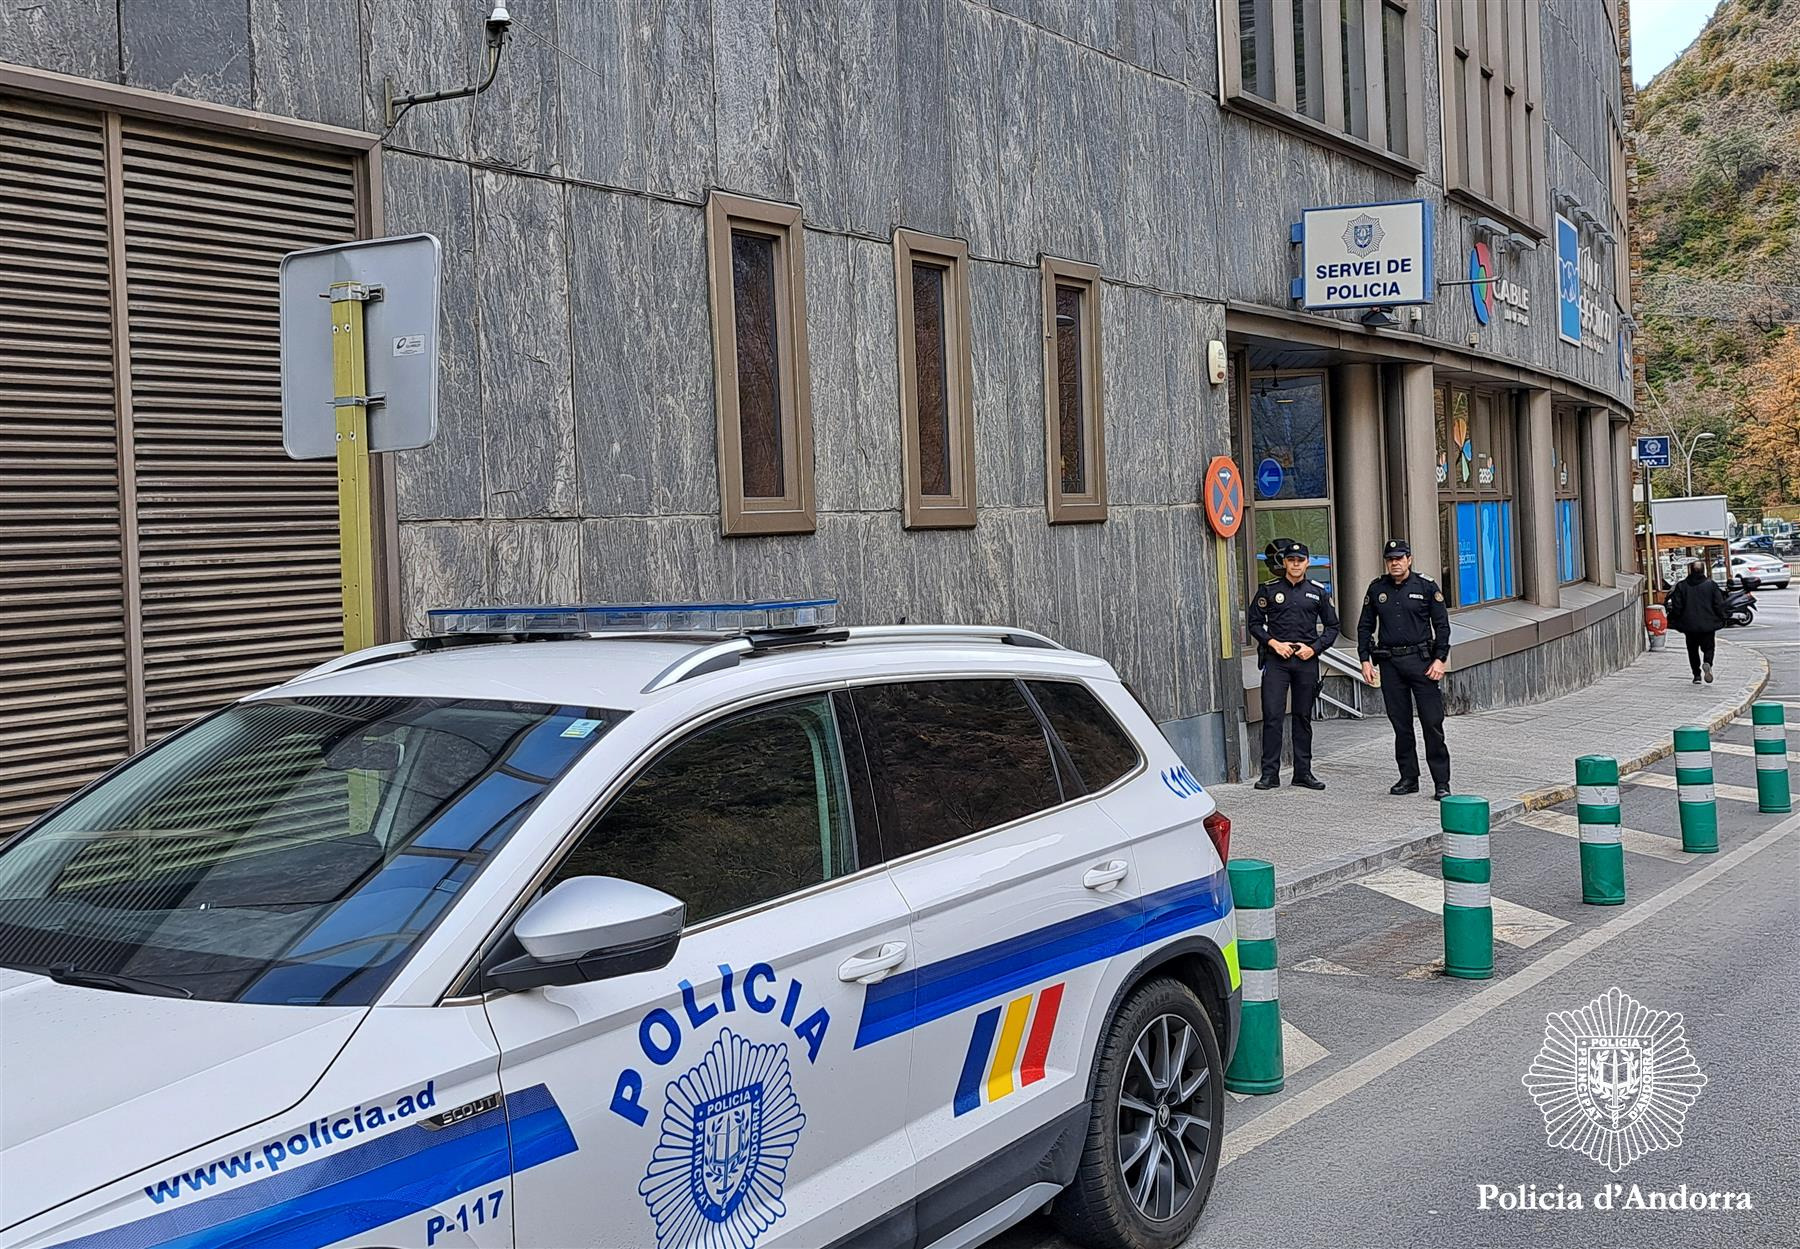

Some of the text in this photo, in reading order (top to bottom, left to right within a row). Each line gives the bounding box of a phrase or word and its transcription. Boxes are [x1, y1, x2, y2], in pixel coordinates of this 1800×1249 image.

[1316, 258, 1412, 279] SERVEI DE
[1327, 281, 1401, 300] POLICIA
[1170, 765, 1202, 796] 110
[609, 962, 831, 1128] POLICIA
[442, 1095, 494, 1124] SCOUT
[707, 1090, 751, 1117] POLICIA
[144, 1081, 437, 1205] www.policia.ad
[692, 1119, 713, 1211] PRINCIPAT
[738, 1099, 762, 1195] D'ANDORRA
[426, 1189, 505, 1246] P-117
